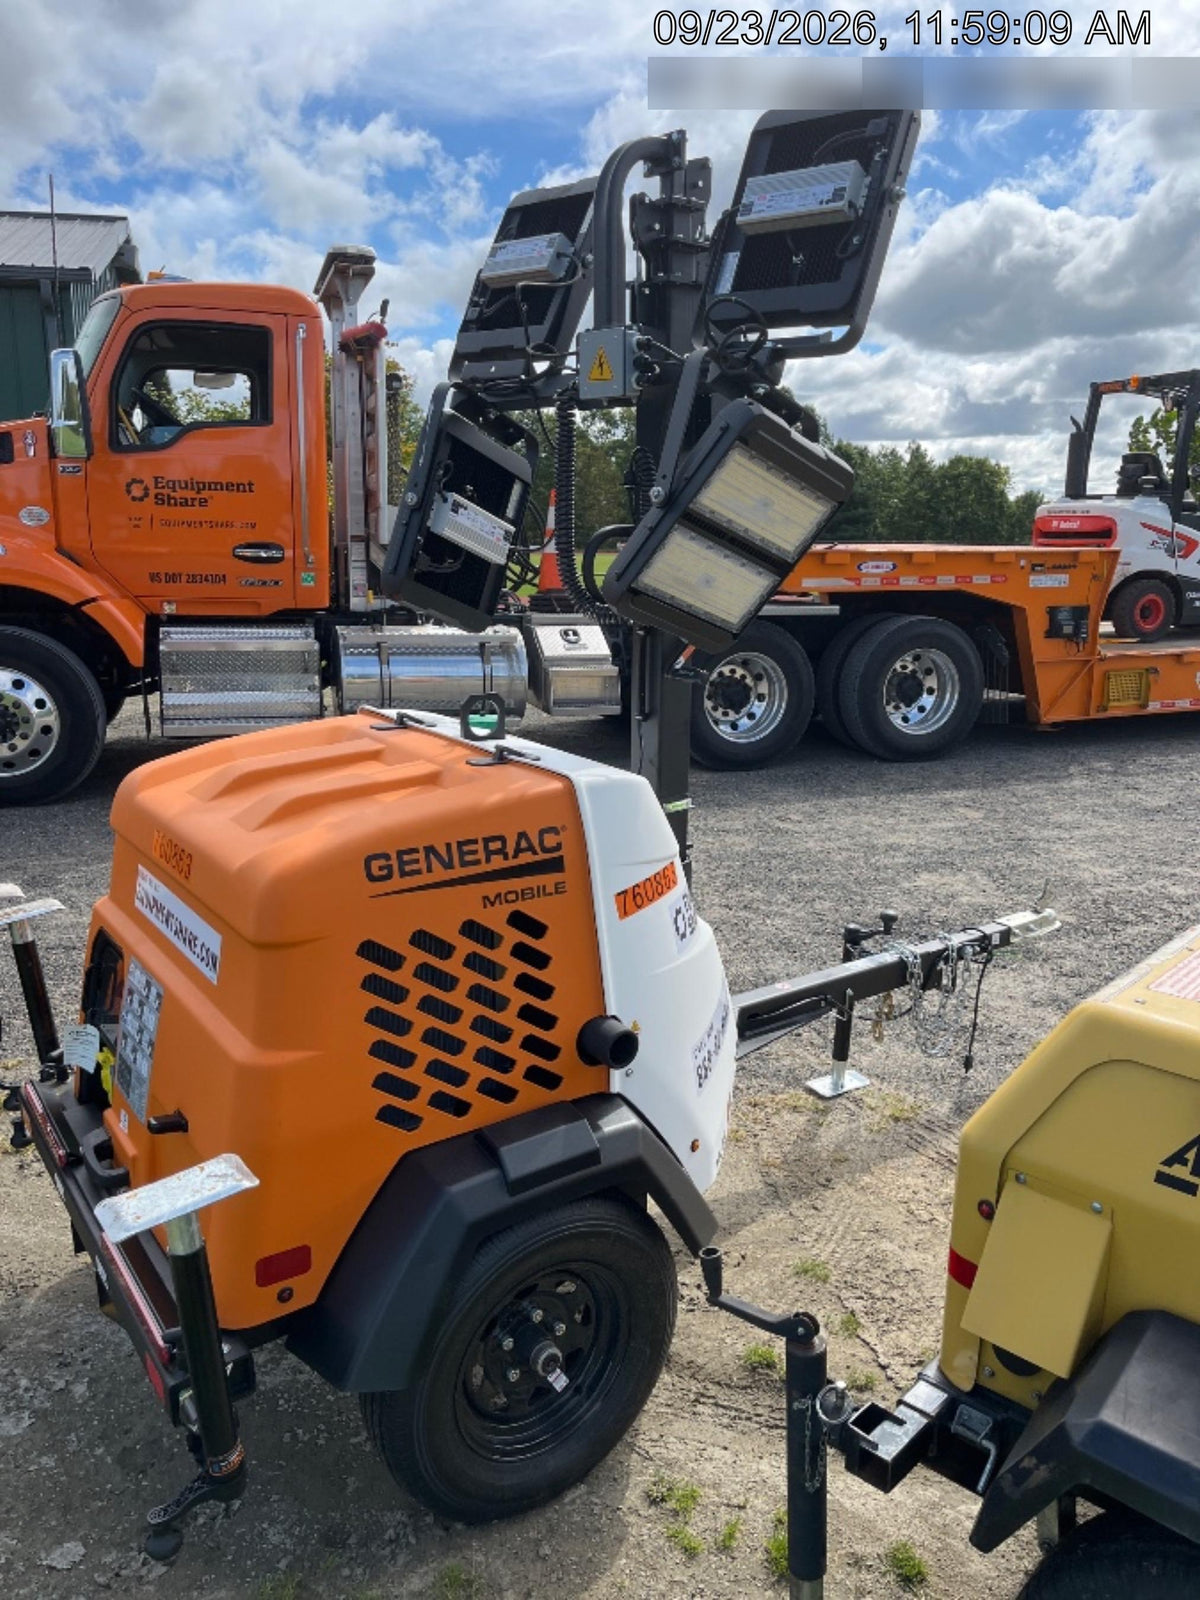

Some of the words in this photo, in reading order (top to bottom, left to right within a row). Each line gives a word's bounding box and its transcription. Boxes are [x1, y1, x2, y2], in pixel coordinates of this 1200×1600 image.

[153, 476, 254, 494] Equipment
[154, 493, 209, 507] Share
[149, 572, 162, 584] US
[164, 572, 182, 584] DOT
[364, 826, 563, 882] GENERAC
[482, 881, 568, 909] MOBILE
